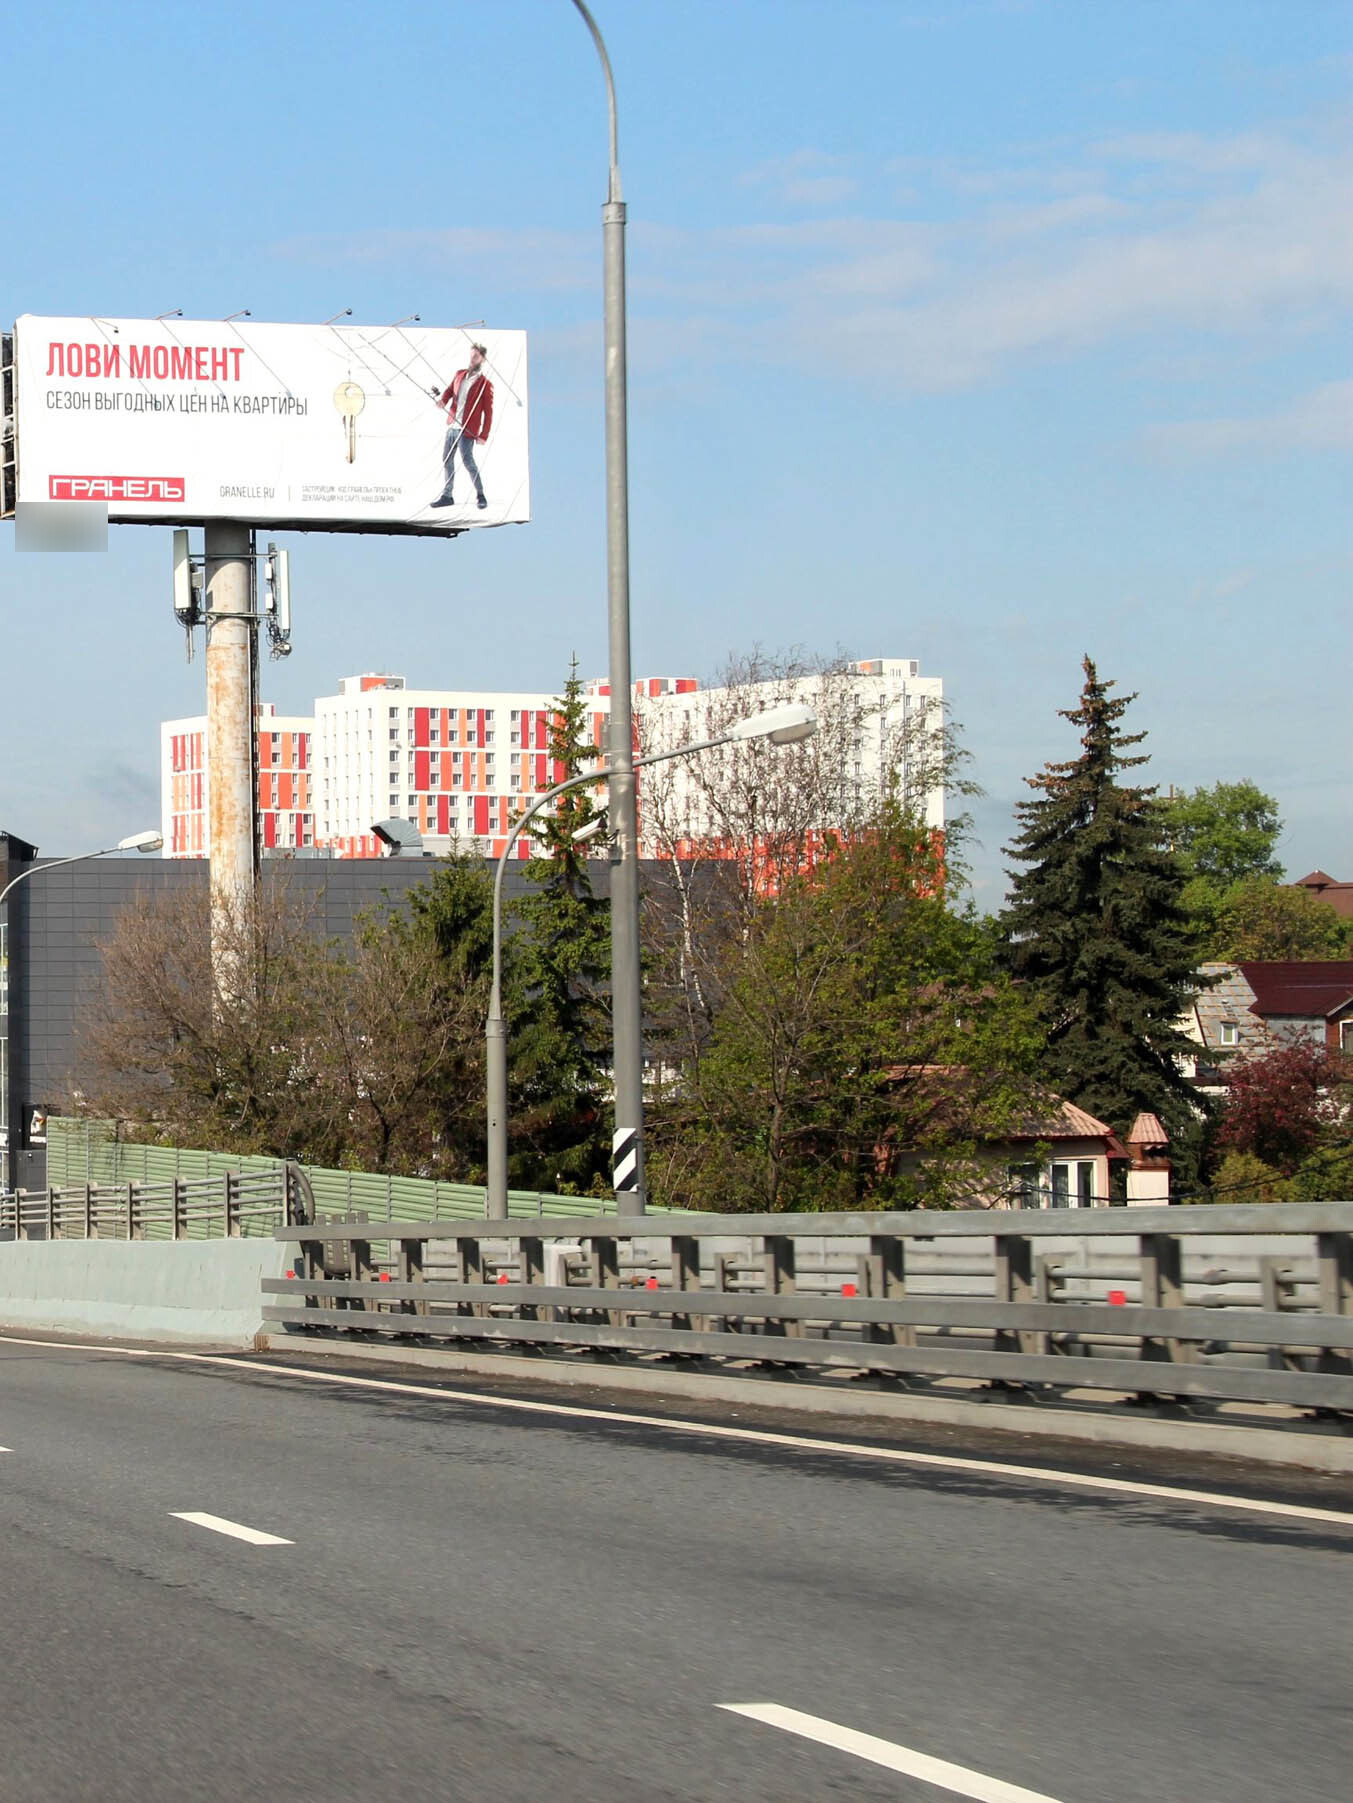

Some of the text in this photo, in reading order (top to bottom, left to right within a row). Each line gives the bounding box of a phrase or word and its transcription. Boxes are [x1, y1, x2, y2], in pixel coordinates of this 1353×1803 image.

[46, 342, 245, 381] ЛОВИ МОМЕНТ
[46, 390, 307, 416] СЕЗОН ВЫГОДНЫХ ЦЕН НА КВАРТИРЫ
[52, 478, 183, 499] ГРАНЕЛЬ
